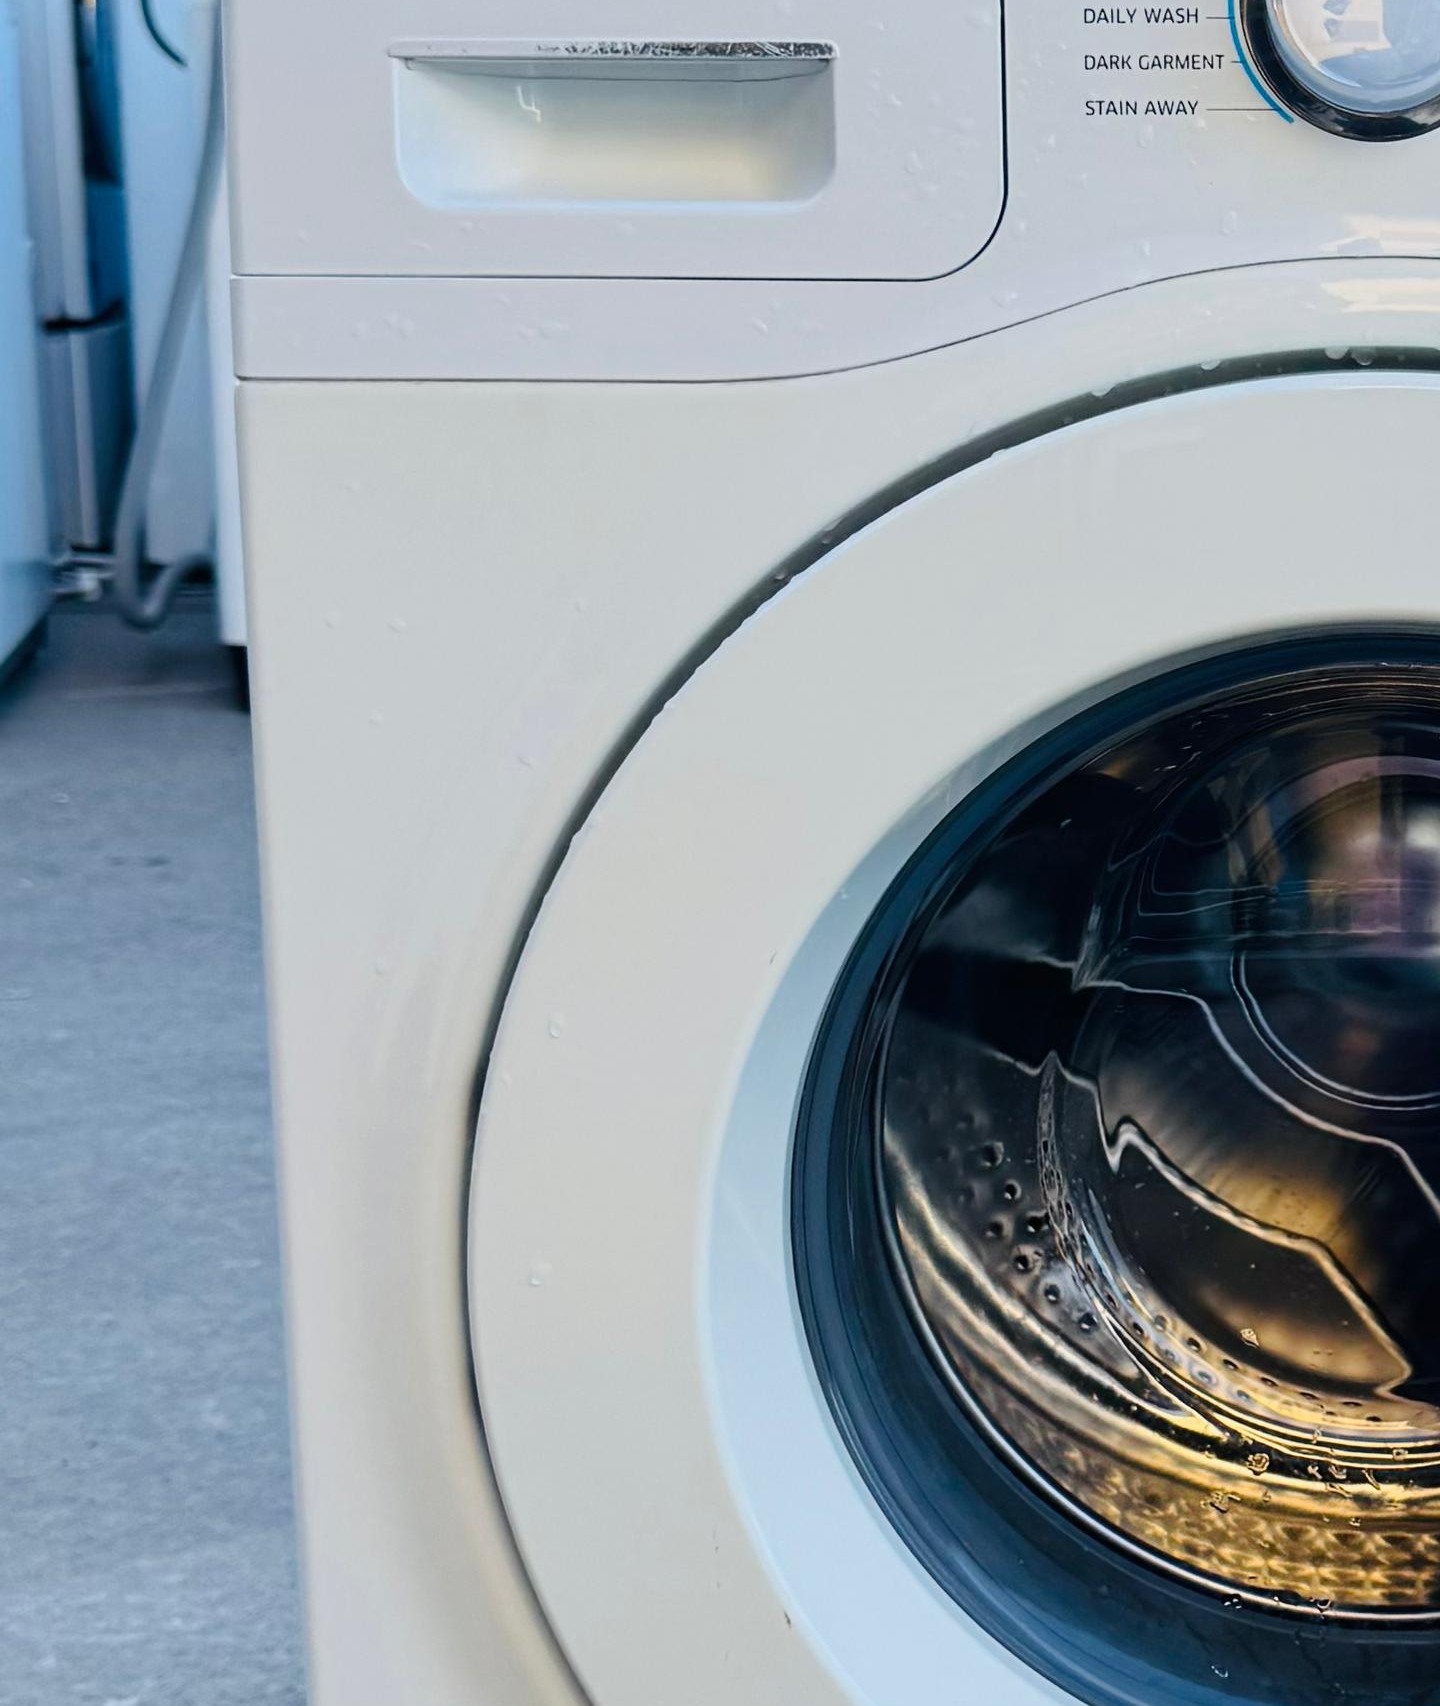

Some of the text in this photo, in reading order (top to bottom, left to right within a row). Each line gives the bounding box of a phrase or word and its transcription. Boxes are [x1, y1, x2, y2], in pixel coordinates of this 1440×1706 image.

[1083, 7, 1199, 24] DAILY WASH
[1084, 54, 1225, 71] DARK GARMENT
[1085, 100, 1199, 116] STAIN AWAY
